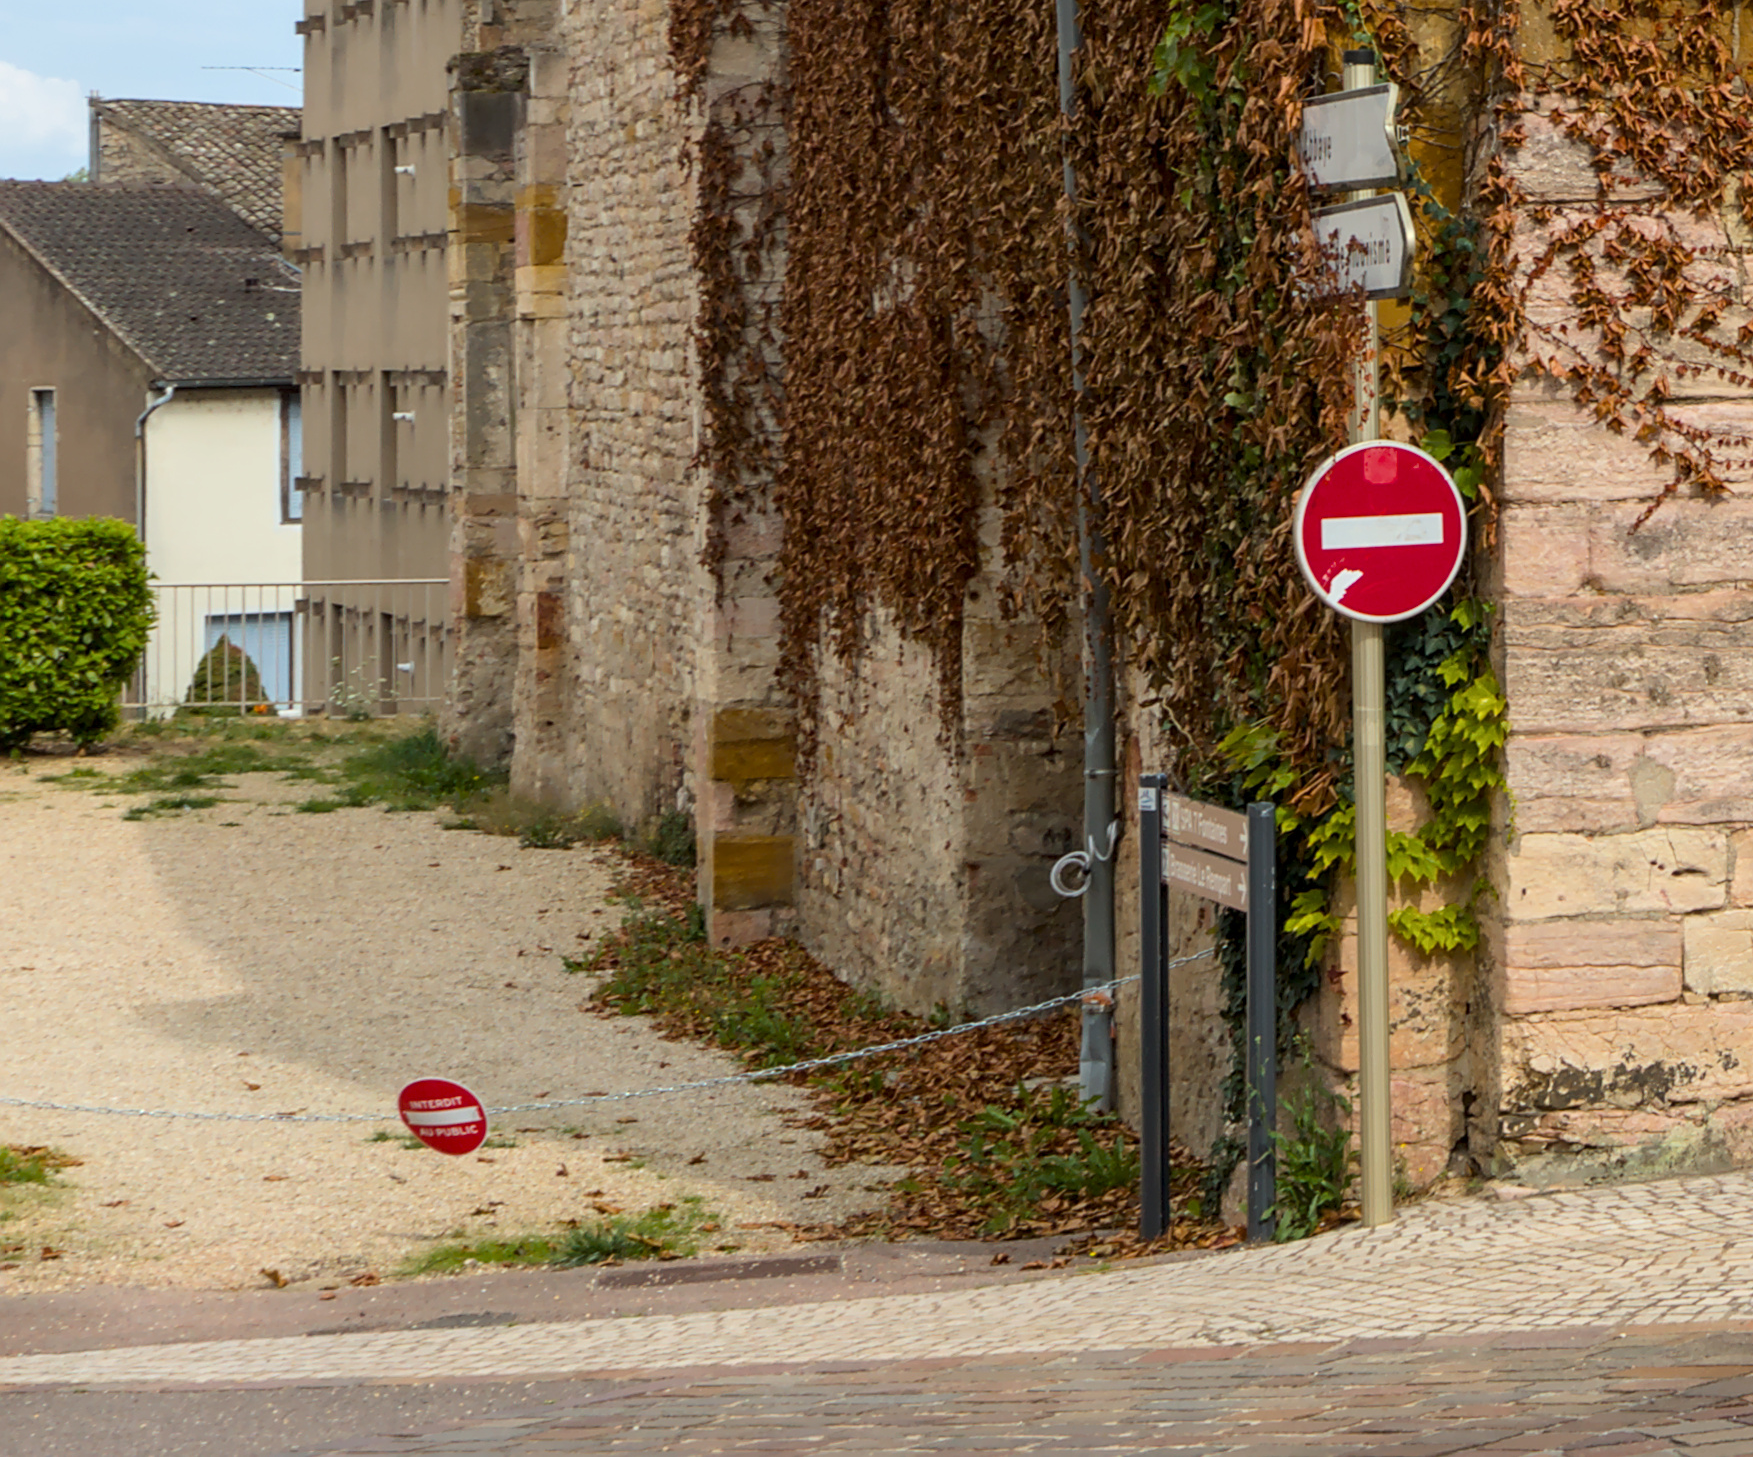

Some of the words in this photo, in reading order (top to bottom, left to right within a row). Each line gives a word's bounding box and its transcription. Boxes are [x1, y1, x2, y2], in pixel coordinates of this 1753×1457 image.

[409, 1096, 462, 1109] INTERDIT
[420, 1127, 434, 1137] AU
[435, 1125, 478, 1137] PUBLIC
